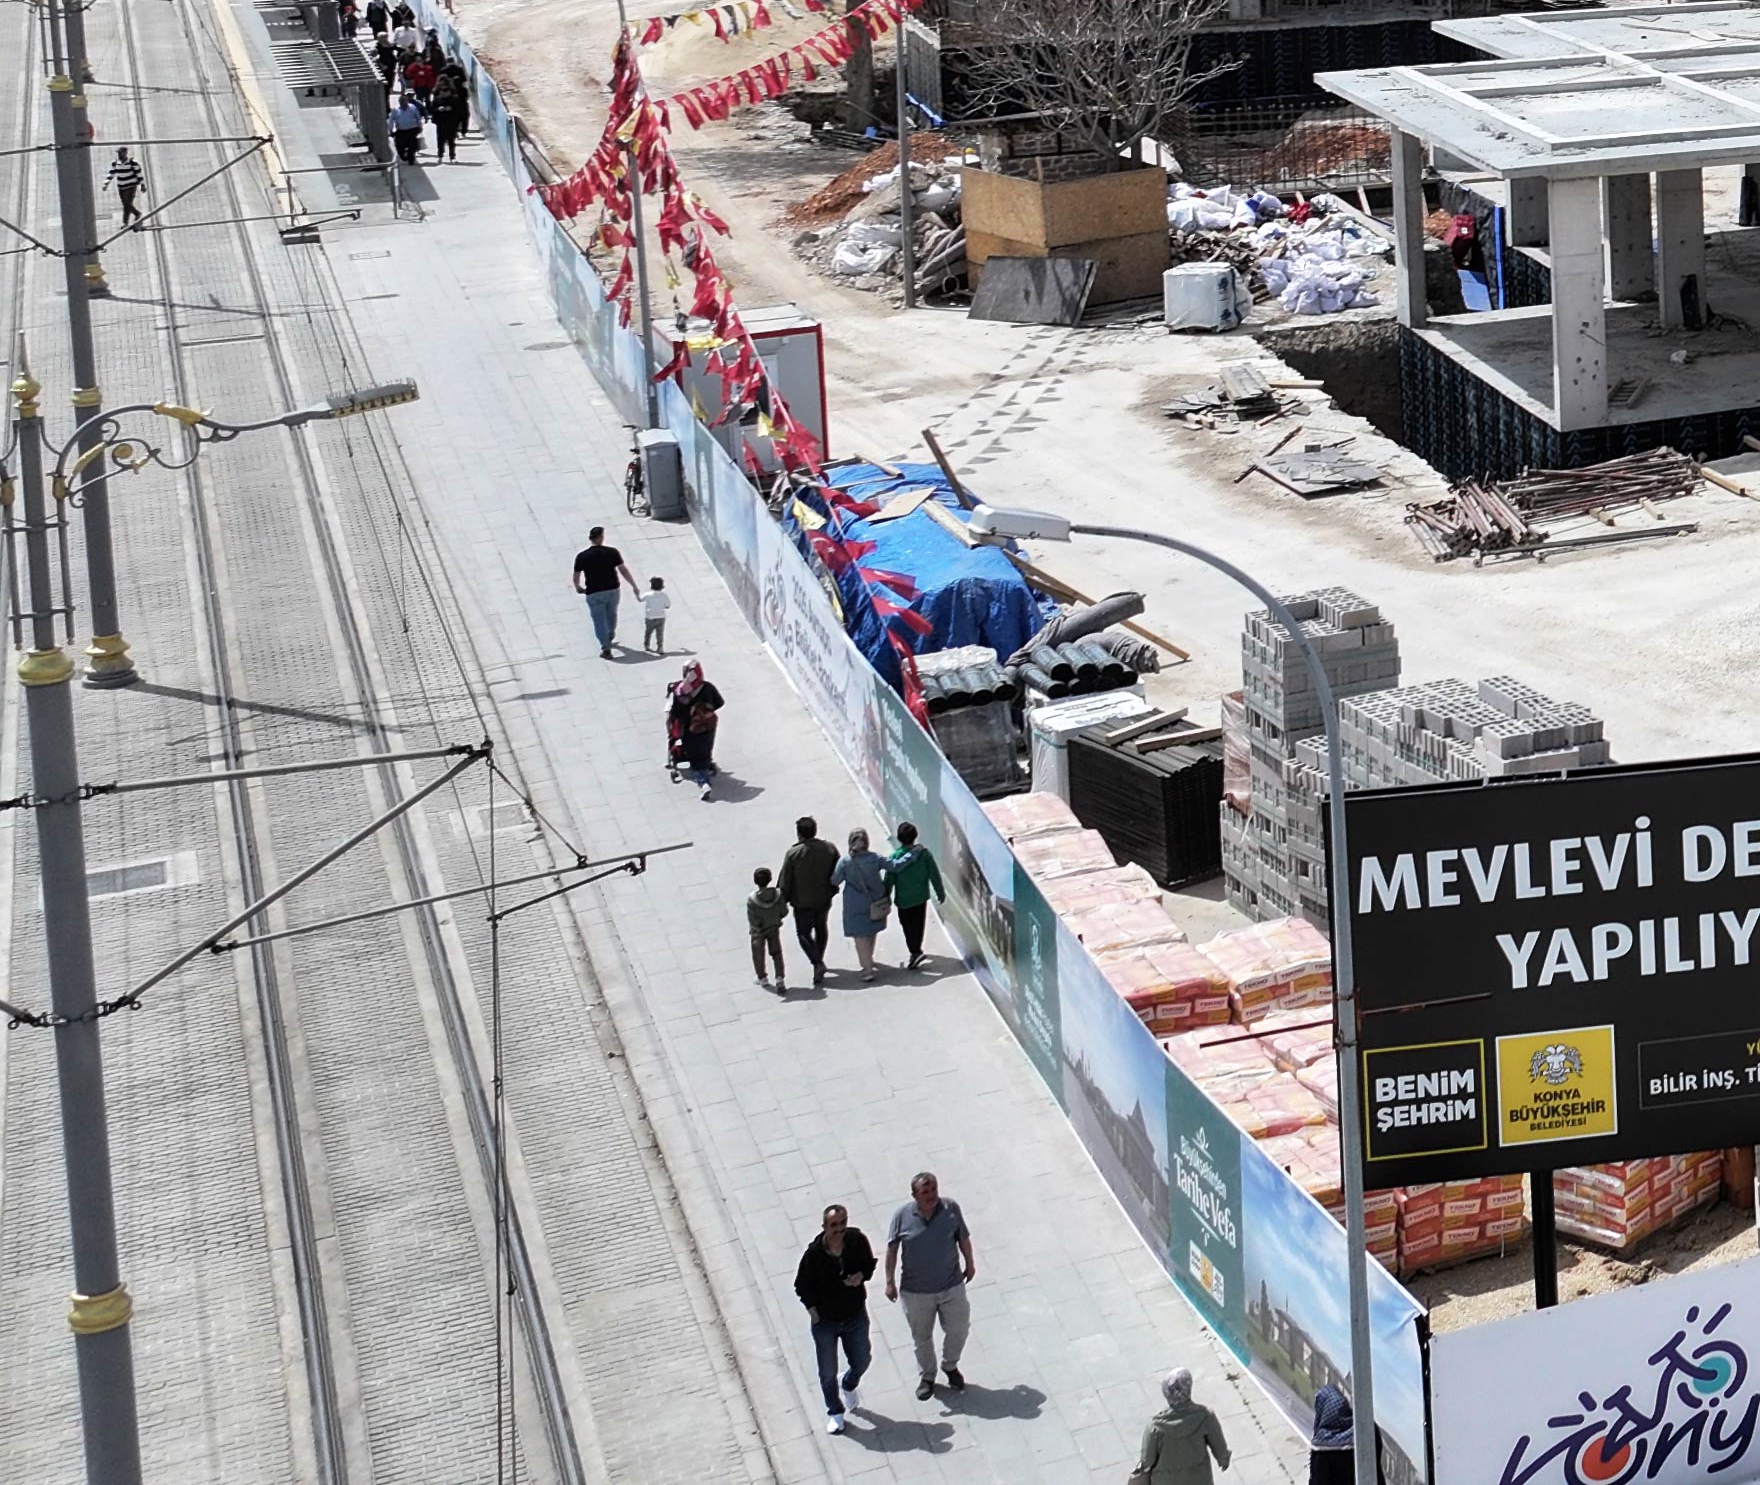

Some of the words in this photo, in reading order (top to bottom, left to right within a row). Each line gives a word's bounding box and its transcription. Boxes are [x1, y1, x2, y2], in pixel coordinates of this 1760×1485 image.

[1358, 816, 1655, 913] MEVLEVİ
[1375, 1067, 1476, 1103] BENİM
[1533, 1087, 1581, 1103] KONYA
[1649, 1069, 1699, 1096] BİLİR
[1703, 1064, 1741, 1092] İNŞ.
[1376, 1097, 1476, 1133] ŞEHRİM
[1509, 1097, 1607, 1123] BÜYÜKŞEHİR
[1529, 1114, 1588, 1132] BELEDİYESİ
[1173, 1152, 1210, 1219] Tarihe
[1209, 1191, 1237, 1249] Vefa
